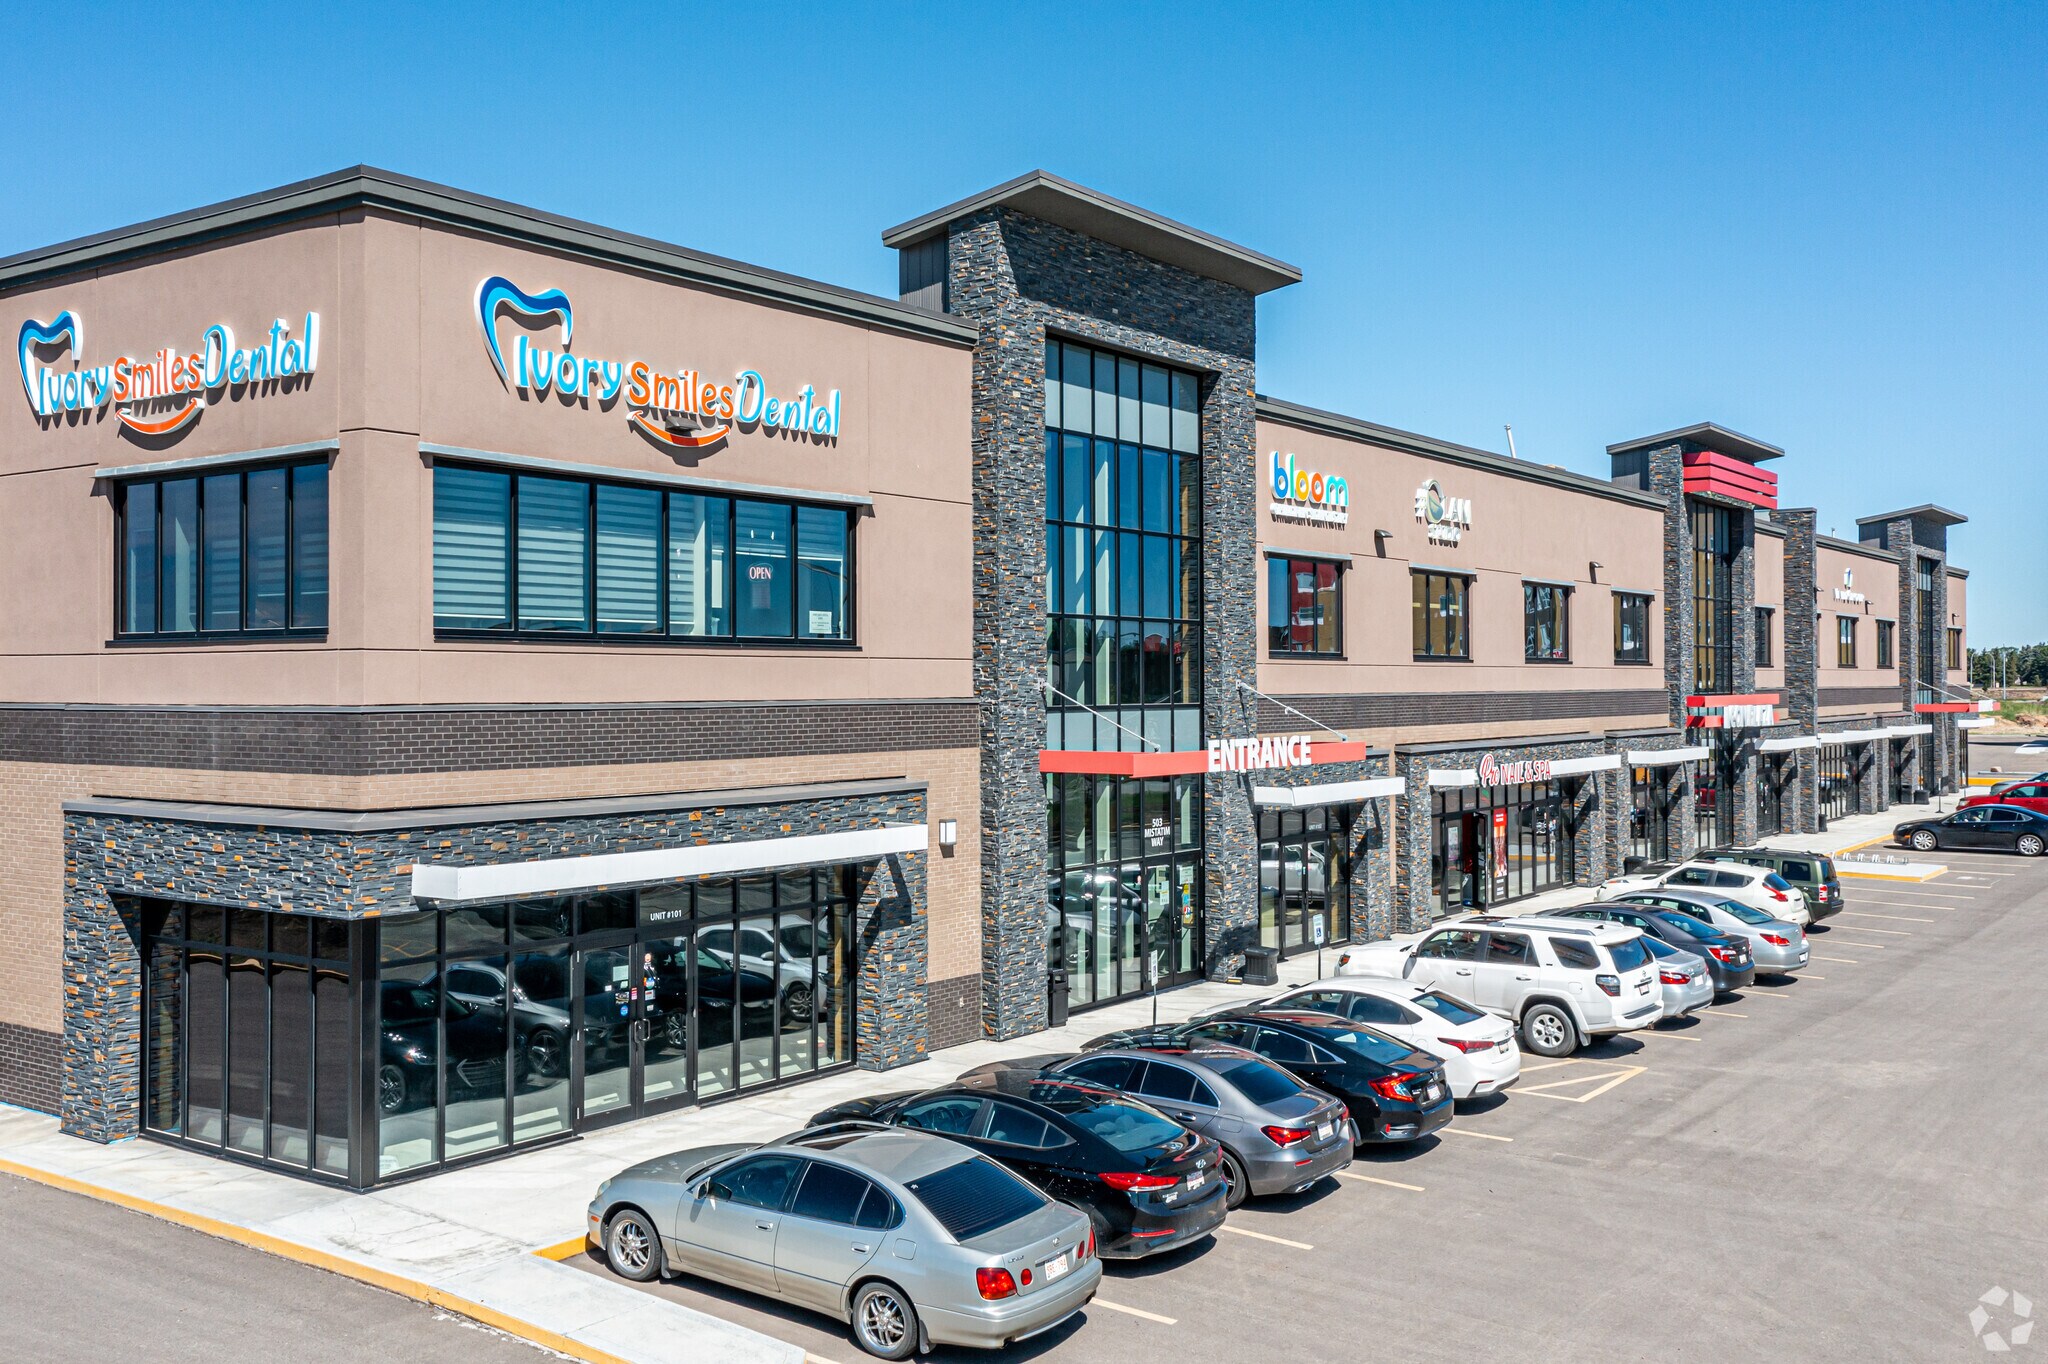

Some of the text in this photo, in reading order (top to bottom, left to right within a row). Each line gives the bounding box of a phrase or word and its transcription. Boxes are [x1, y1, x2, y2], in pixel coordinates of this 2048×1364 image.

[38, 365, 113, 416] Ivory
[203, 311, 320, 388] Dental
[513, 335, 623, 401] Ivory
[735, 369, 842, 437] Dental
[1269, 450, 1349, 507] bloom
[749, 566, 772, 580] OPEN
[1208, 735, 1312, 773] ENTRANCE
[1480, 754, 1551, 788] Pro NAIL & SPA
[1144, 826, 1171, 838] MISTATIM
[1152, 818, 1163, 828] 503
[1151, 837, 1164, 847] WAY
[650, 911, 666, 921] UNIT
